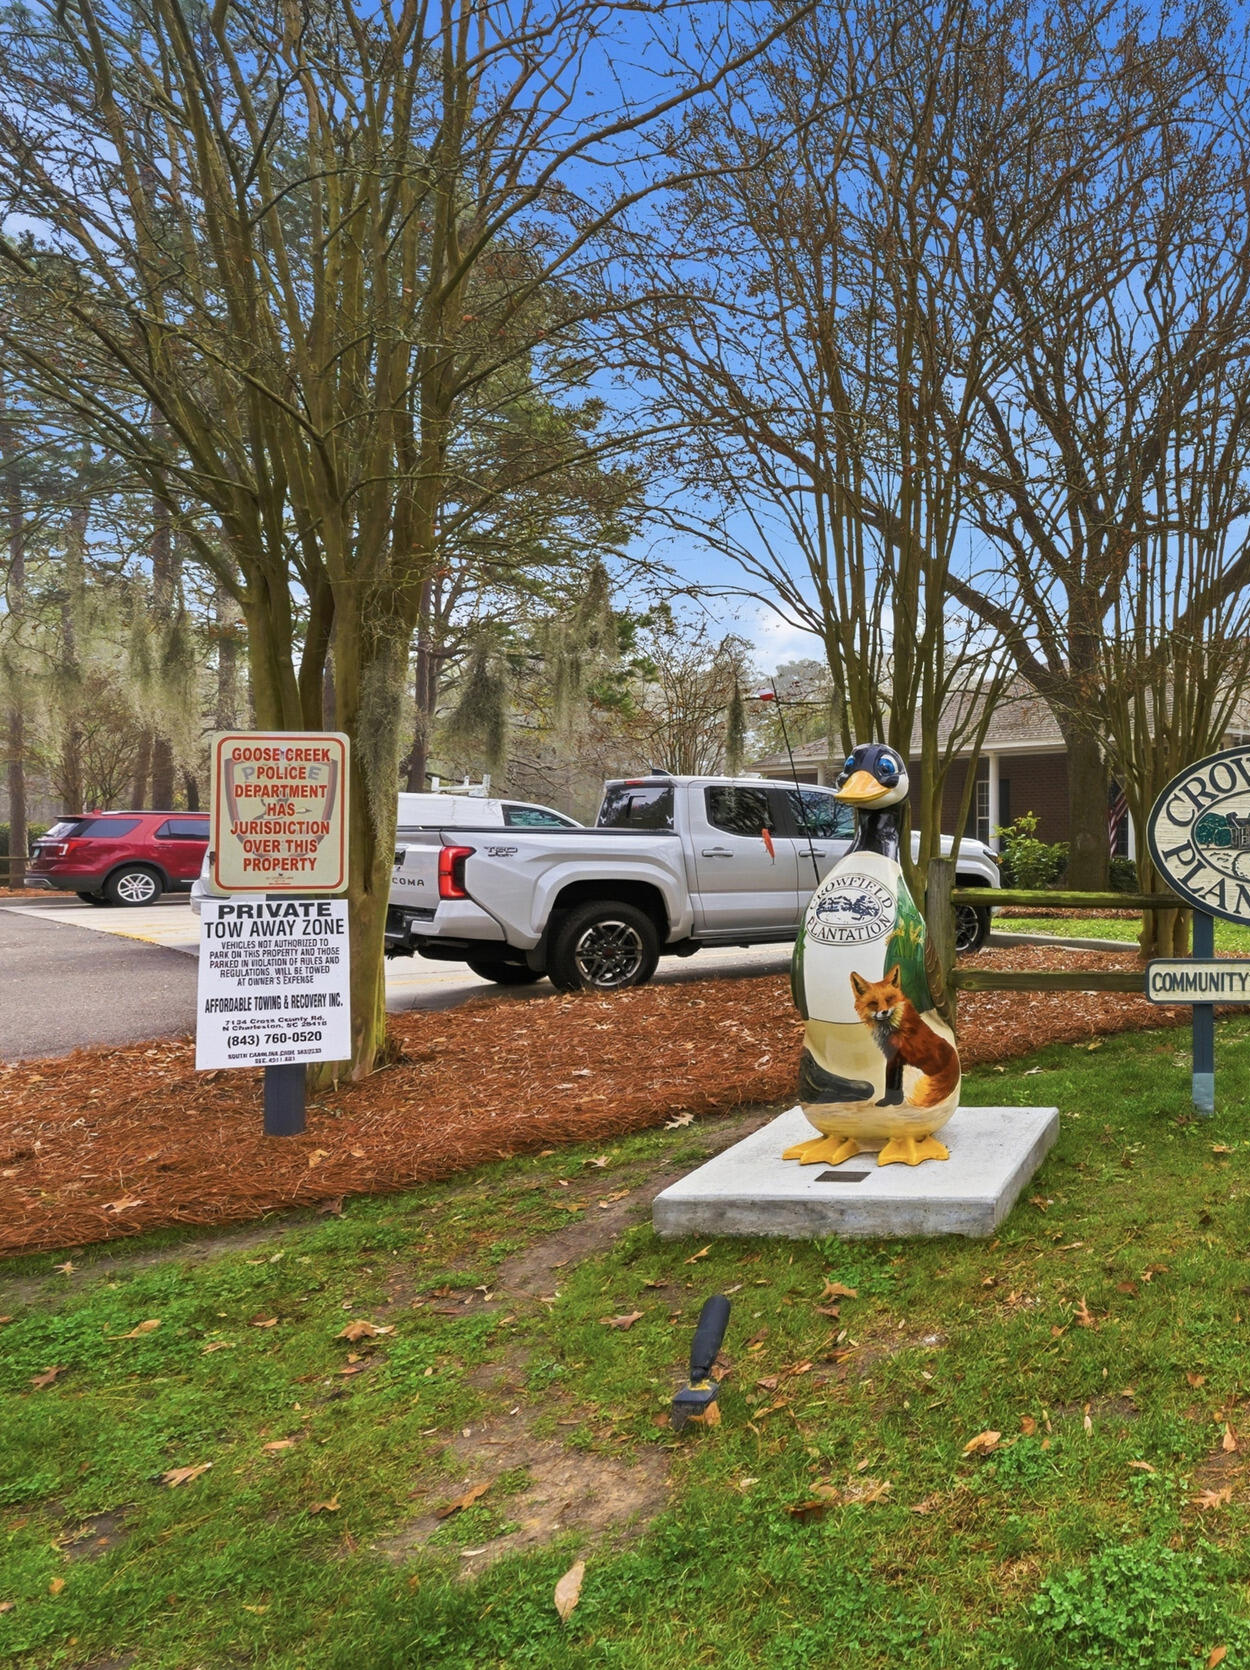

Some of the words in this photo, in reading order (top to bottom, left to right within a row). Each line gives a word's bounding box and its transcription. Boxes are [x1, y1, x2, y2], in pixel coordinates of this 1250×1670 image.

[232, 748, 280, 762] GOOSE
[285, 748, 330, 762] CREEK
[256, 766, 306, 780] POLICE
[234, 784, 327, 798] DEPARTMENT
[267, 803, 295, 816] HAS
[230, 821, 330, 835] JURISDICTION
[243, 840, 281, 853] OVER
[286, 839, 318, 853] THIS
[243, 858, 317, 872] PROPERTY
[392, 877, 425, 886] COMA
[218, 902, 332, 920] PRIVATE
[204, 922, 243, 939] TOW
[250, 920, 296, 937] AWAY
[302, 918, 344, 936] ZONE
[806, 914, 891, 940] PLANTATION
[221, 941, 255, 950] VEHICLES
[258, 940, 272, 948] NOT
[274, 939, 317, 948] AUTHORIZED
[320, 939, 329, 947] TO
[209, 951, 229, 959] PARK
[232, 950, 241, 958] ON
[244, 950, 260, 958] THIS
[262, 948, 298, 958] PROPERTY
[300, 948, 314, 956] AND
[317, 947, 340, 955] THOSE
[209, 960, 238, 969] PARKED
[241, 959, 249, 967] IN
[251, 958, 287, 967] VIOLATION
[289, 957, 298, 966] OF
[300, 957, 323, 965] RULES
[325, 956, 340, 964] AND
[275, 967, 292, 976] WILL
[294, 966, 303, 974] BE
[305, 965, 330, 974] TOWED
[237, 978, 245, 986] AT
[283, 975, 314, 984] EXPENSE
[1152, 972, 1249, 992] COMMUNITY
[205, 996, 252, 1013] AFFORDABLE
[254, 995, 281, 1011] TOWING
[283, 994, 289, 1010] &
[291, 993, 327, 1009] RECOVERY
[329, 992, 343, 1007] INC.
[227, 1035, 260, 1048] (843)
[264, 1031, 322, 1044] 760-0520
